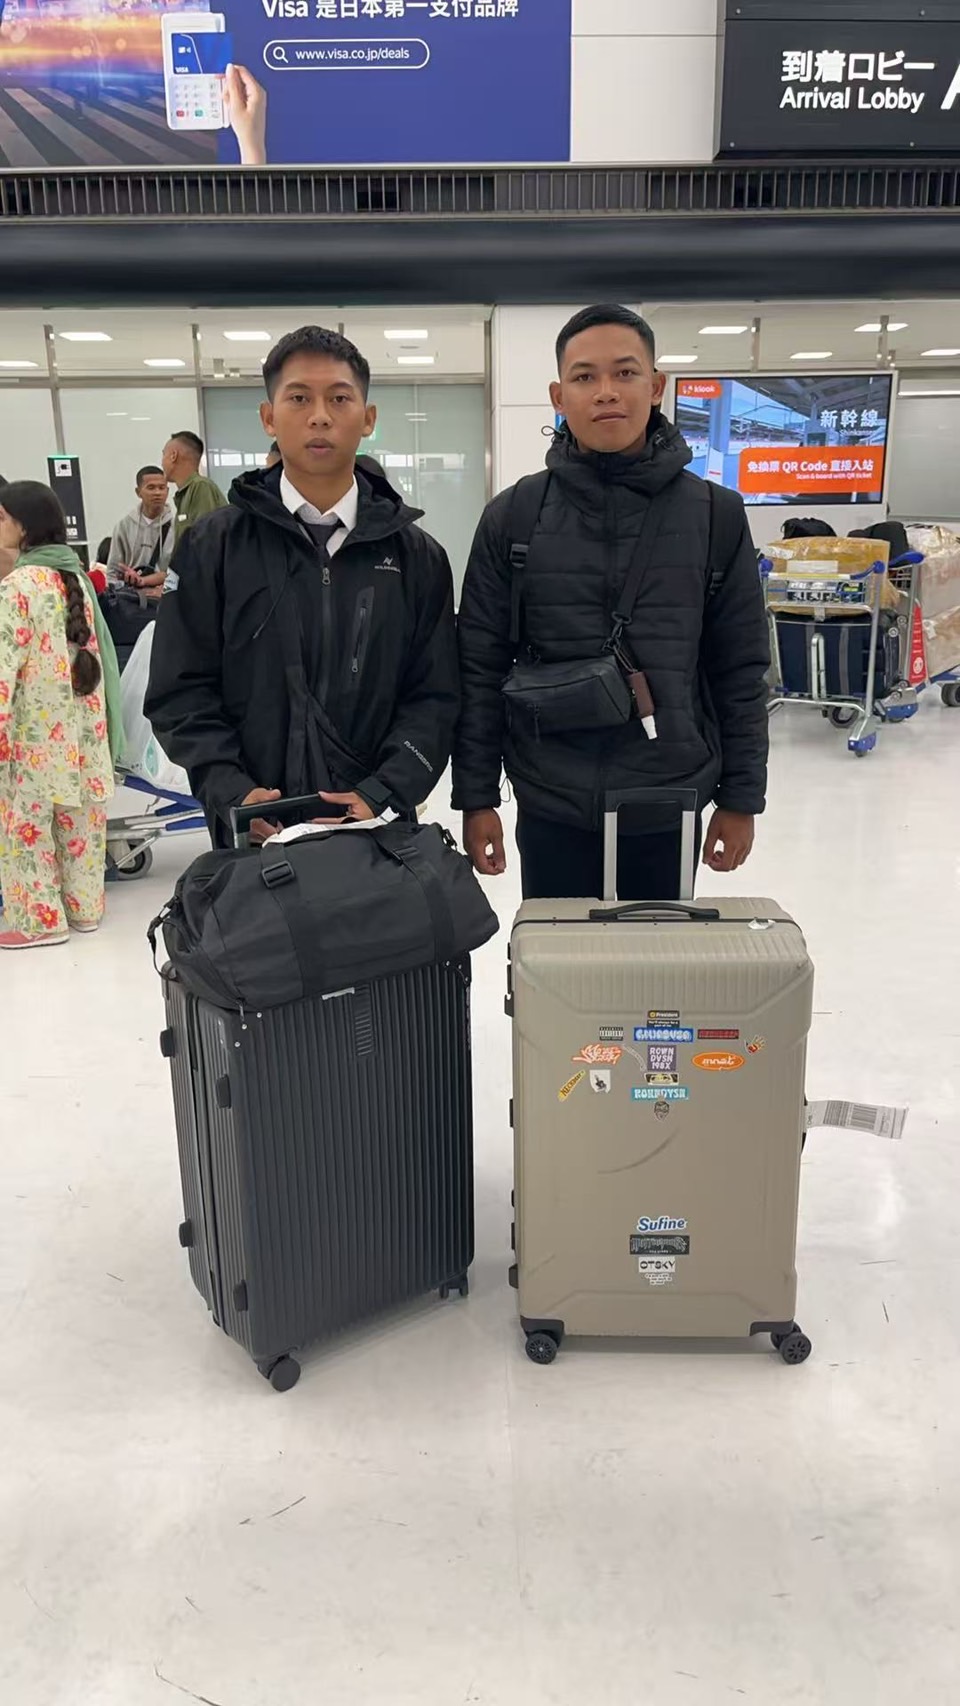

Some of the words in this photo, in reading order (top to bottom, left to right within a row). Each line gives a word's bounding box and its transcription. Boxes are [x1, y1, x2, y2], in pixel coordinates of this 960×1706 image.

[263, 0, 309, 18] Visa
[315, 0, 519, 18] 是日本第一支付品牌
[295, 47, 410, 61] www.visa.co.jp/deals
[781, 50, 935, 83] 到着ロビー
[779, 86, 851, 109] Arrival
[857, 87, 925, 114] Lobby
[820, 409, 879, 429] 新幹線
[782, 461, 799, 474] QR
[800, 461, 828, 472] Code
[638, 1217, 686, 1231] Sufine
